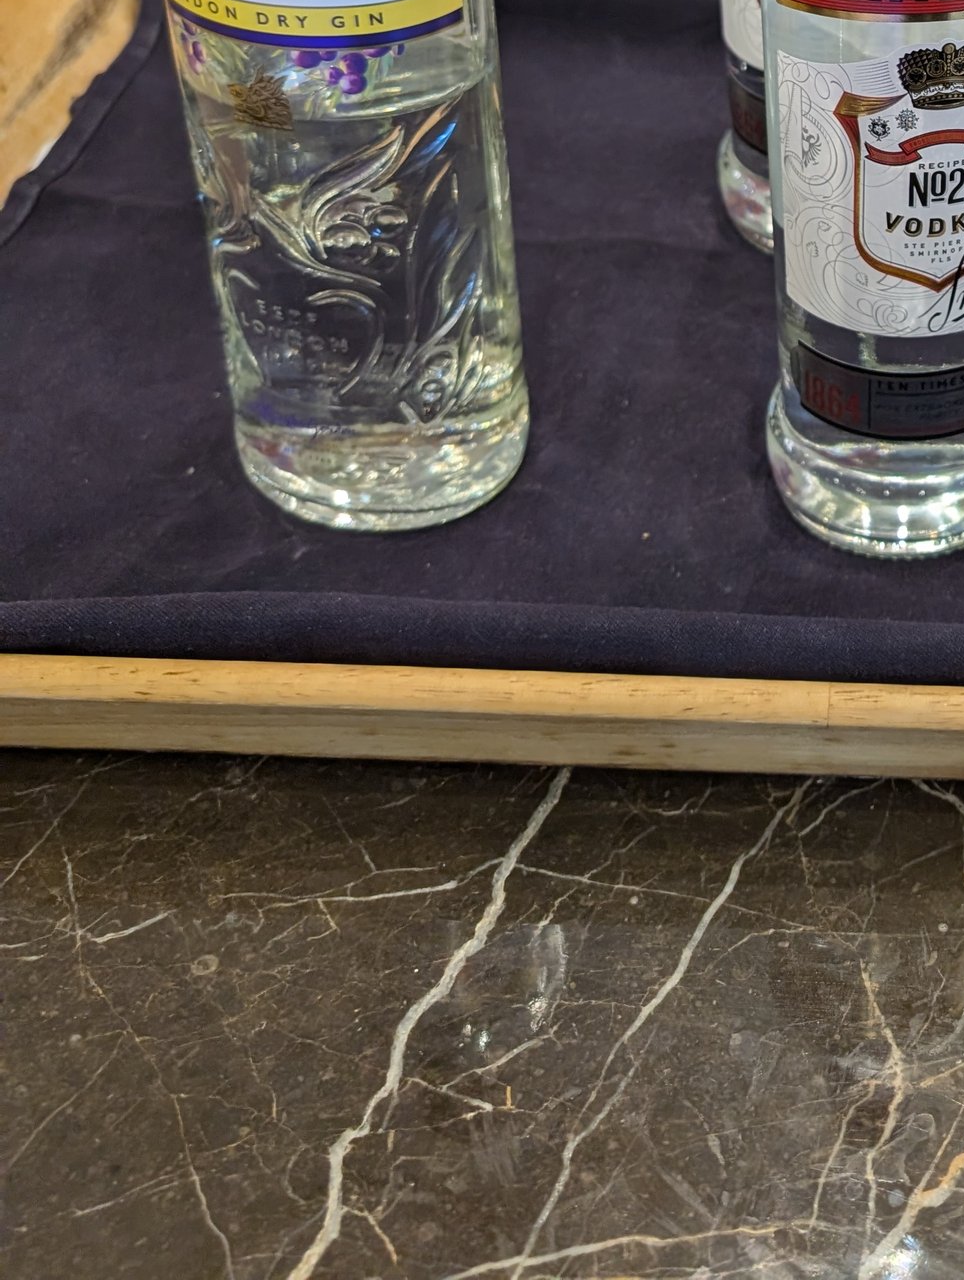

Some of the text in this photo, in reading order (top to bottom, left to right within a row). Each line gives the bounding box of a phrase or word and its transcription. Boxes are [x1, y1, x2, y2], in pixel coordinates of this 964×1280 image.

[256, 12, 307, 28] DRY
[331, 12, 384, 28] GIN
[877, 379, 908, 391] TEN
